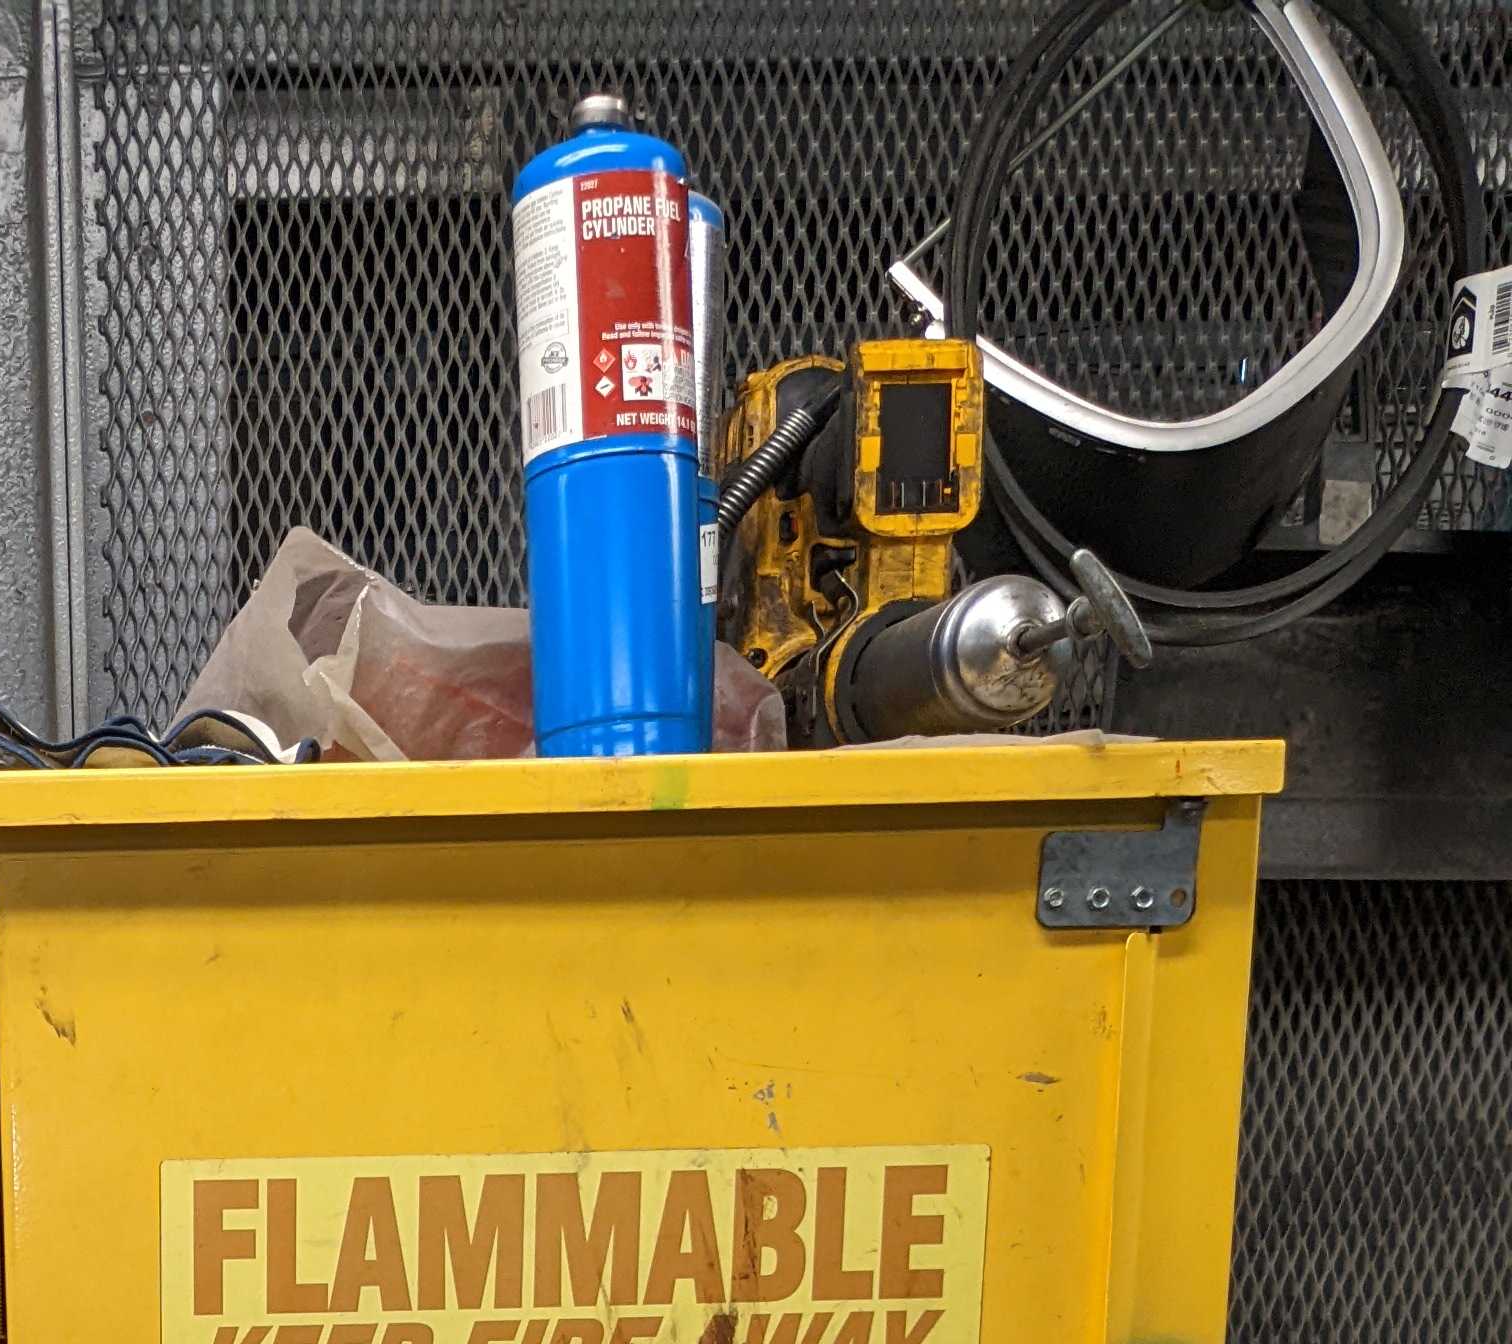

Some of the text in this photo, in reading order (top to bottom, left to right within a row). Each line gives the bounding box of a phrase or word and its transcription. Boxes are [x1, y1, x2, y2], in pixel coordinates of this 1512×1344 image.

[581, 196, 652, 220] PROPANE
[655, 199, 681, 222] FUEL
[582, 216, 656, 241] CYLINDER
[616, 413, 638, 427] NET
[192, 1164, 948, 1316] FLAMMABLE
